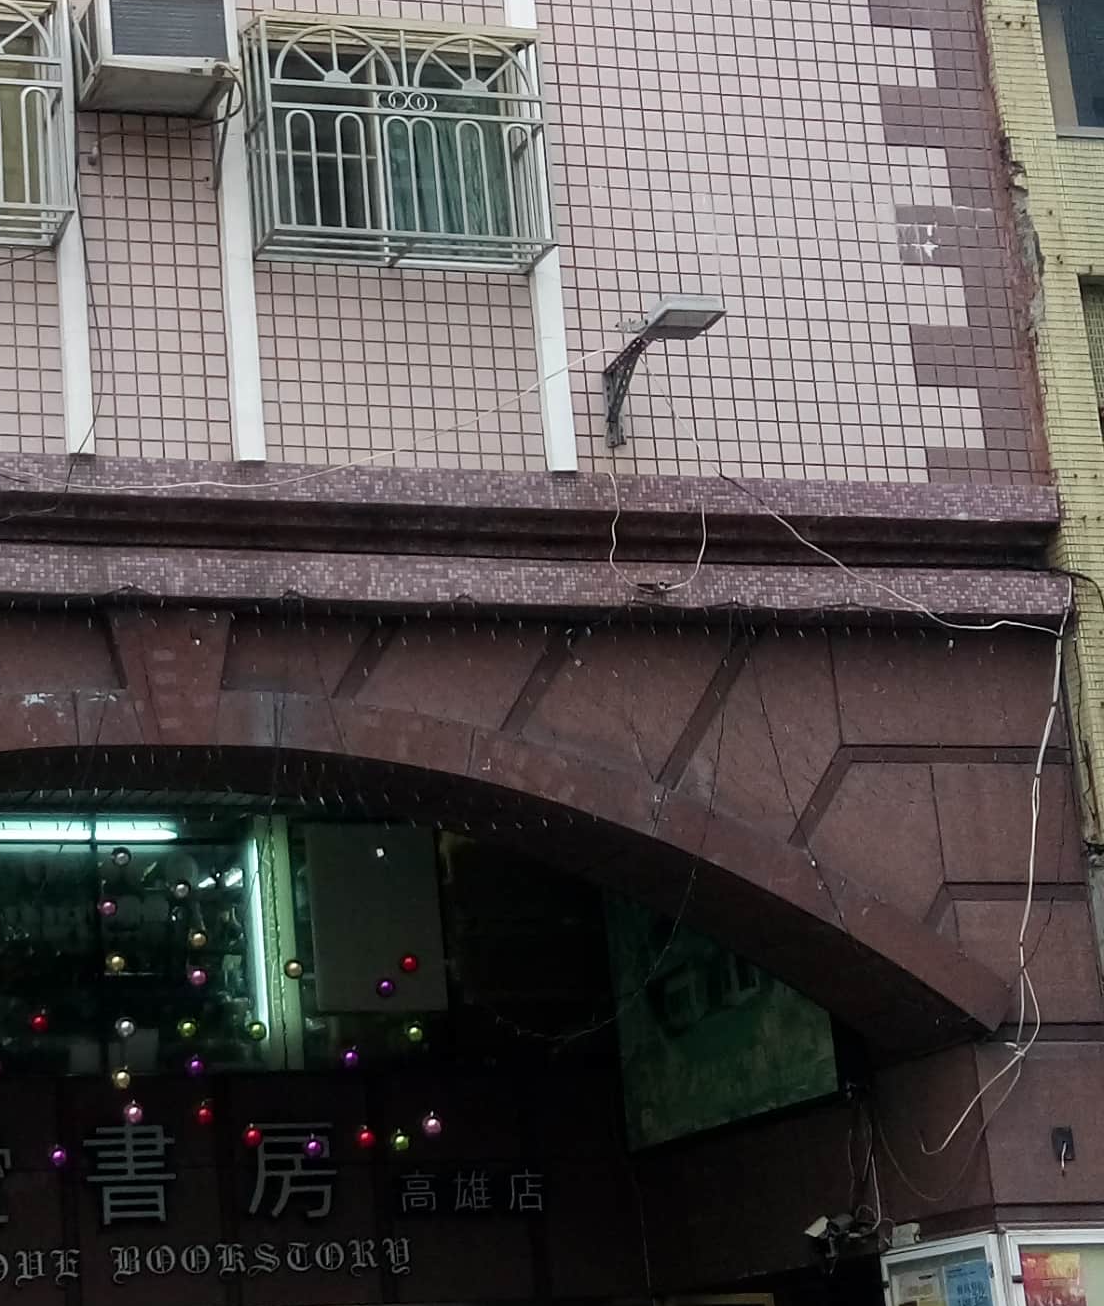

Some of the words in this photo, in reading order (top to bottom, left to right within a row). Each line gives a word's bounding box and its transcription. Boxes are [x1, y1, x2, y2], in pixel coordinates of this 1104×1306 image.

[399, 1169, 545, 1213] 高雄店
[109, 1236, 412, 1285] BOOKSTORY
